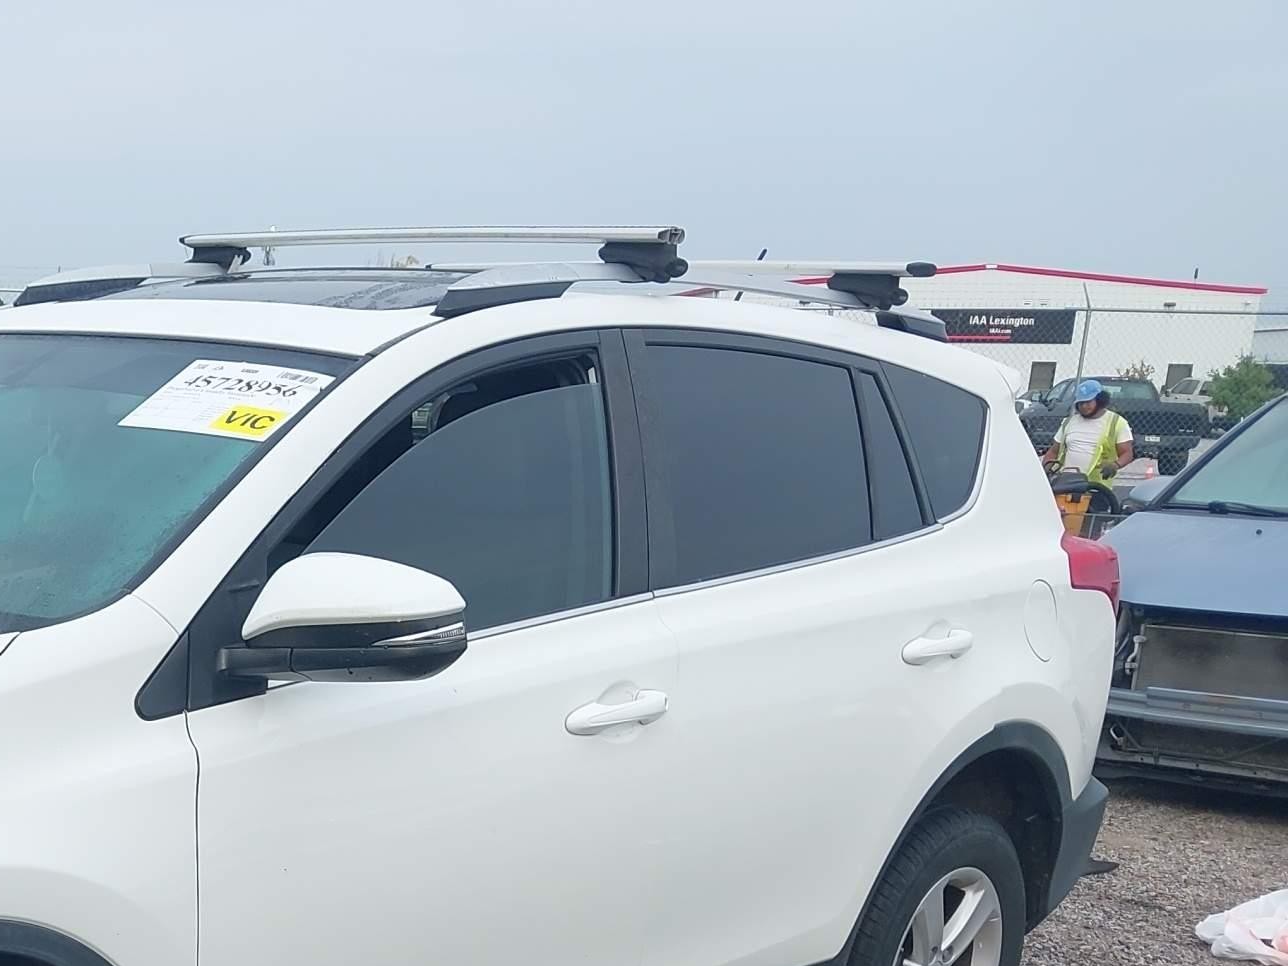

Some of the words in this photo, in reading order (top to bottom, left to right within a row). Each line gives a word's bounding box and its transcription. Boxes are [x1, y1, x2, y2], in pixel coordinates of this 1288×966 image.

[969, 315, 987, 325] IAA
[989, 315, 1035, 327] Lexington
[184, 376, 303, 398] 45728956
[225, 410, 276, 430] VIC
